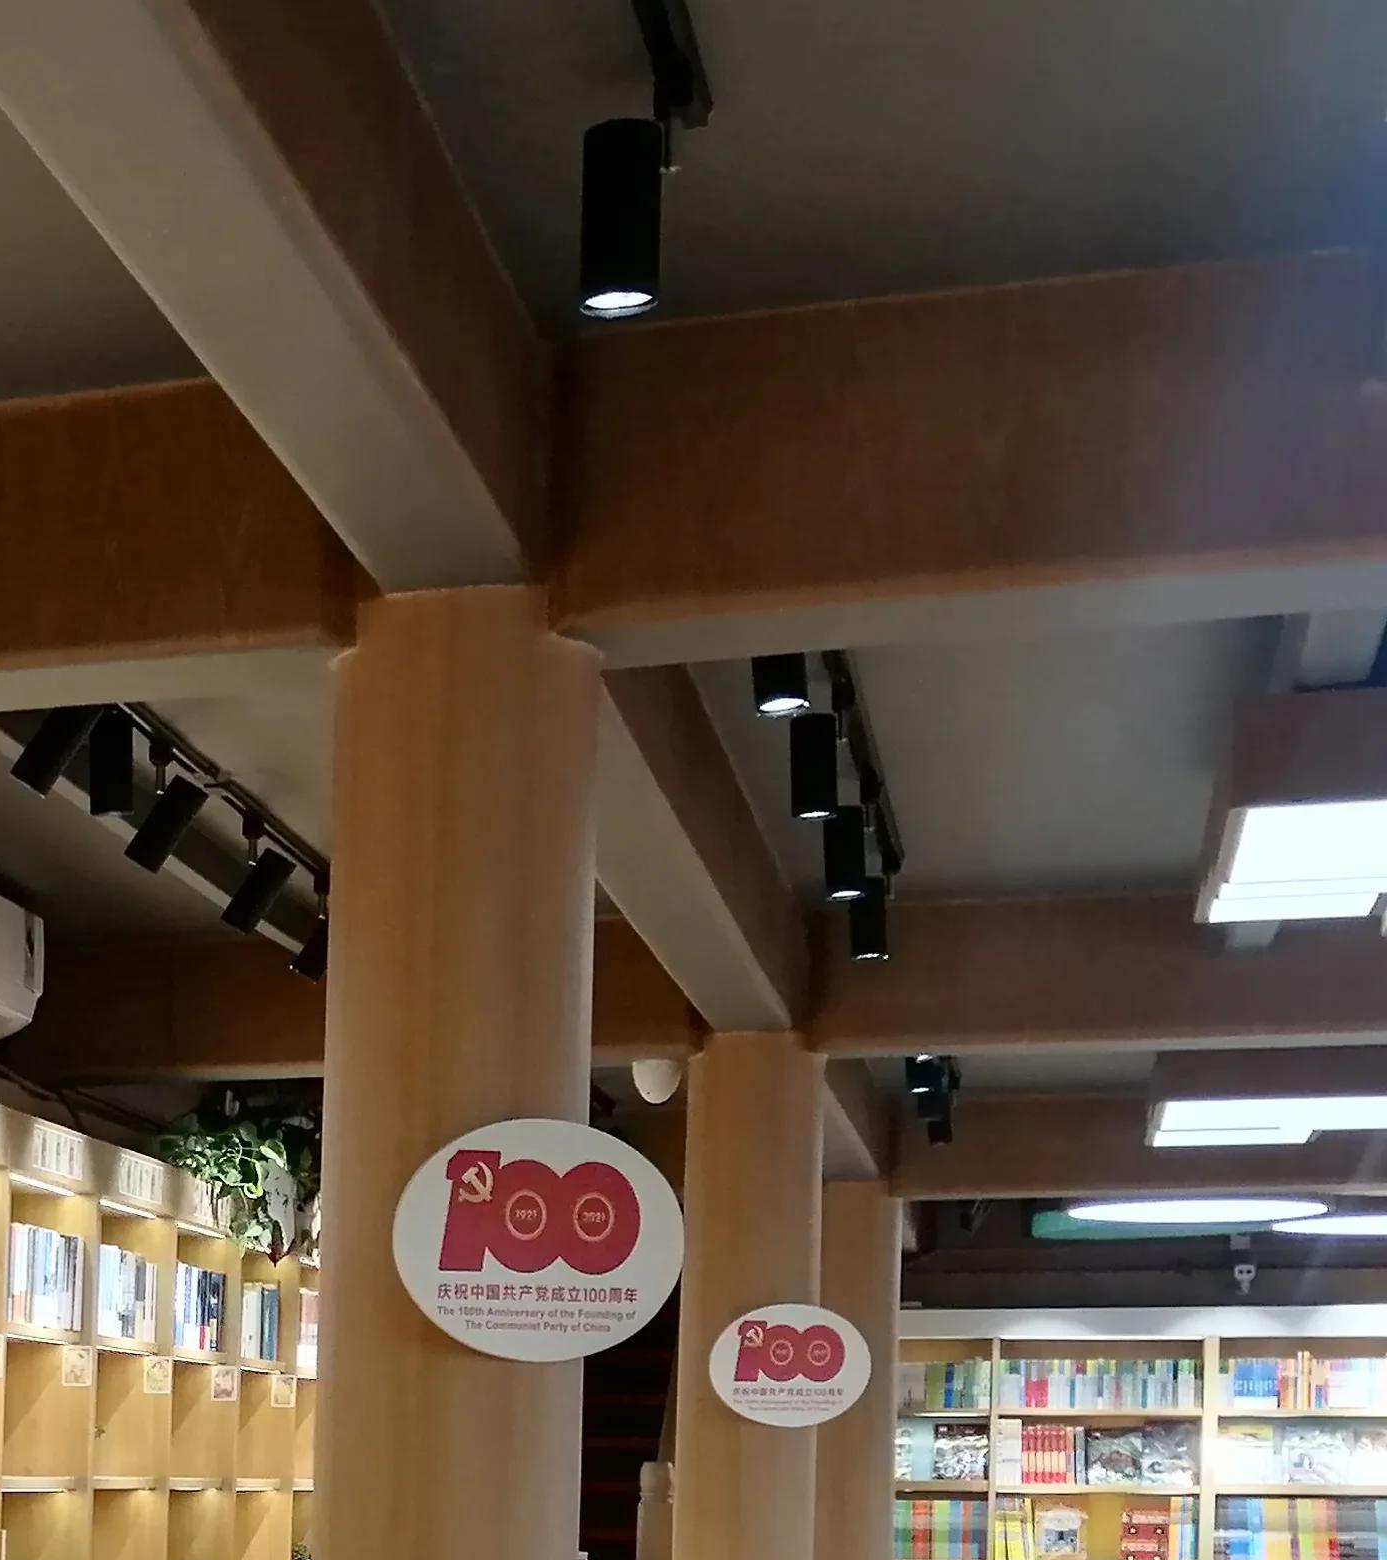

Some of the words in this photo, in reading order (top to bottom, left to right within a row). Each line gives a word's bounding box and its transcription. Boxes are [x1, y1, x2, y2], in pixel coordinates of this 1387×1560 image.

[514, 1208, 538, 1222] 1921
[437, 1283, 638, 1302] 庆祝中国共产党成立100周年
[437, 1305, 455, 1316] The
[487, 1307, 545, 1320] Anniversary
[548, 1309, 558, 1319] of
[560, 1309, 575, 1319] the
[578, 1310, 624, 1322] Founding
[626, 1311, 637, 1320] of
[465, 1319, 482, 1330] The
[485, 1321, 541, 1332] Communist
[543, 1322, 569, 1334] Party
[570, 1323, 581, 1333] of
[583, 1323, 611, 1333] China
